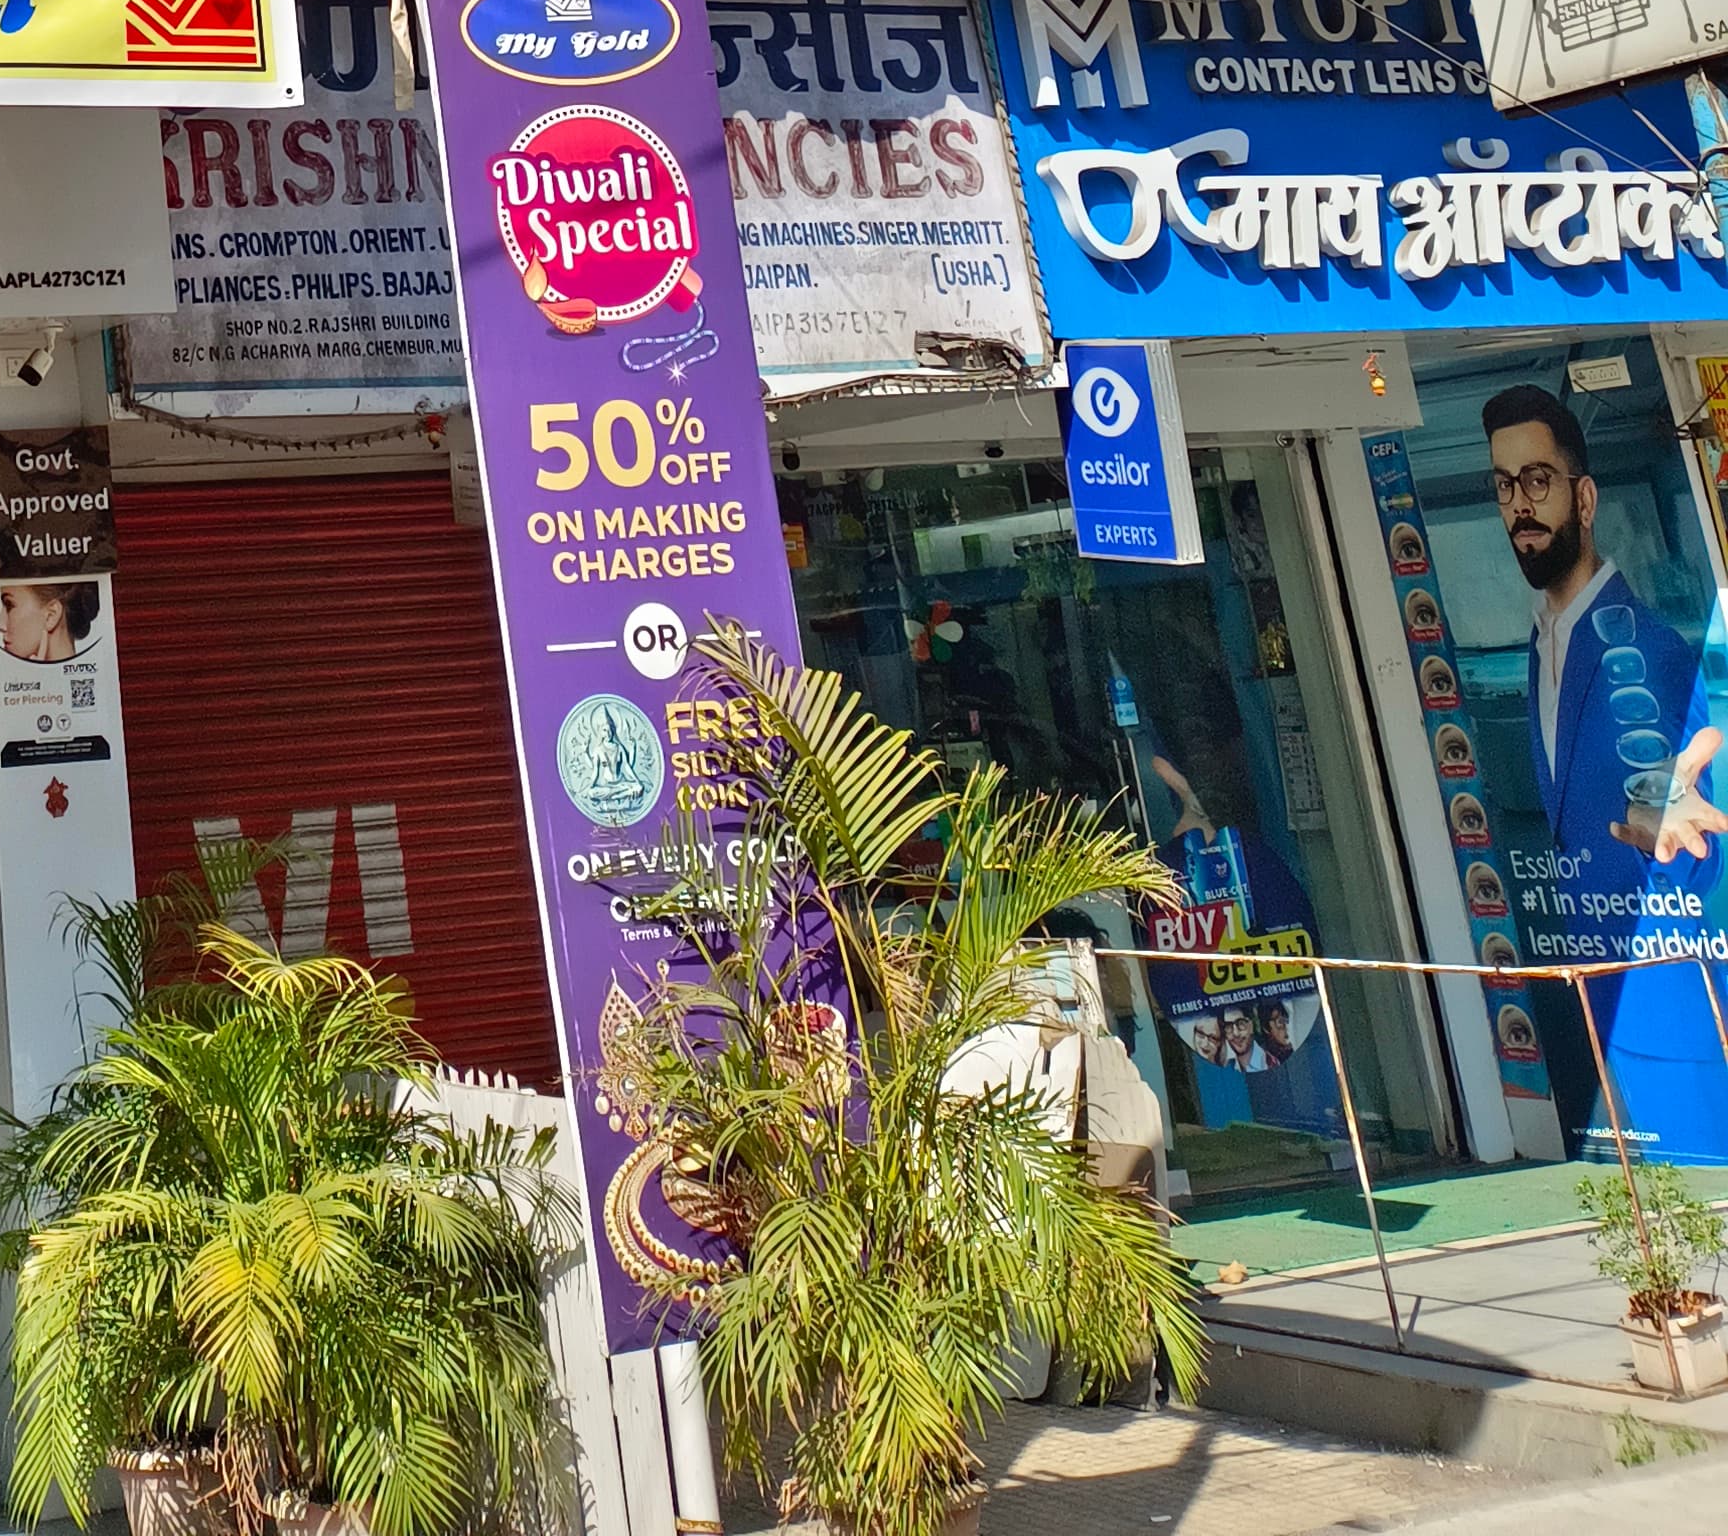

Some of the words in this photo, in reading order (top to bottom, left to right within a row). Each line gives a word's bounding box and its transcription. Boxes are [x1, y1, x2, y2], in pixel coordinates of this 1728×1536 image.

[495, 31, 558, 59] My
[571, 27, 650, 56] Gold
[1193, 56, 1357, 96] CONTACT
[1366, 58, 1456, 95] LENS
[722, 115, 981, 201] NCIES
[492, 152, 651, 207] Diwali
[527, 198, 694, 270] Special
[382, 313, 451, 332] BUILDING
[240, 342, 312, 361] ACHARIYA
[14, 446, 80, 474] Govt.
[658, 451, 733, 487] OFF
[1080, 453, 1152, 488] essilor
[526, 509, 587, 546] ON
[595, 501, 748, 542] MAKING
[1094, 522, 1158, 548] EXPERTS
[13, 532, 93, 560] Valuer
[551, 543, 736, 586] CHARGES
[632, 624, 680, 653] OR
[22, 694, 64, 706] Piercing
[1580, 886, 1703, 923] spectacle
[1154, 908, 1217, 952] BUY
[1528, 926, 1607, 958] lenses
